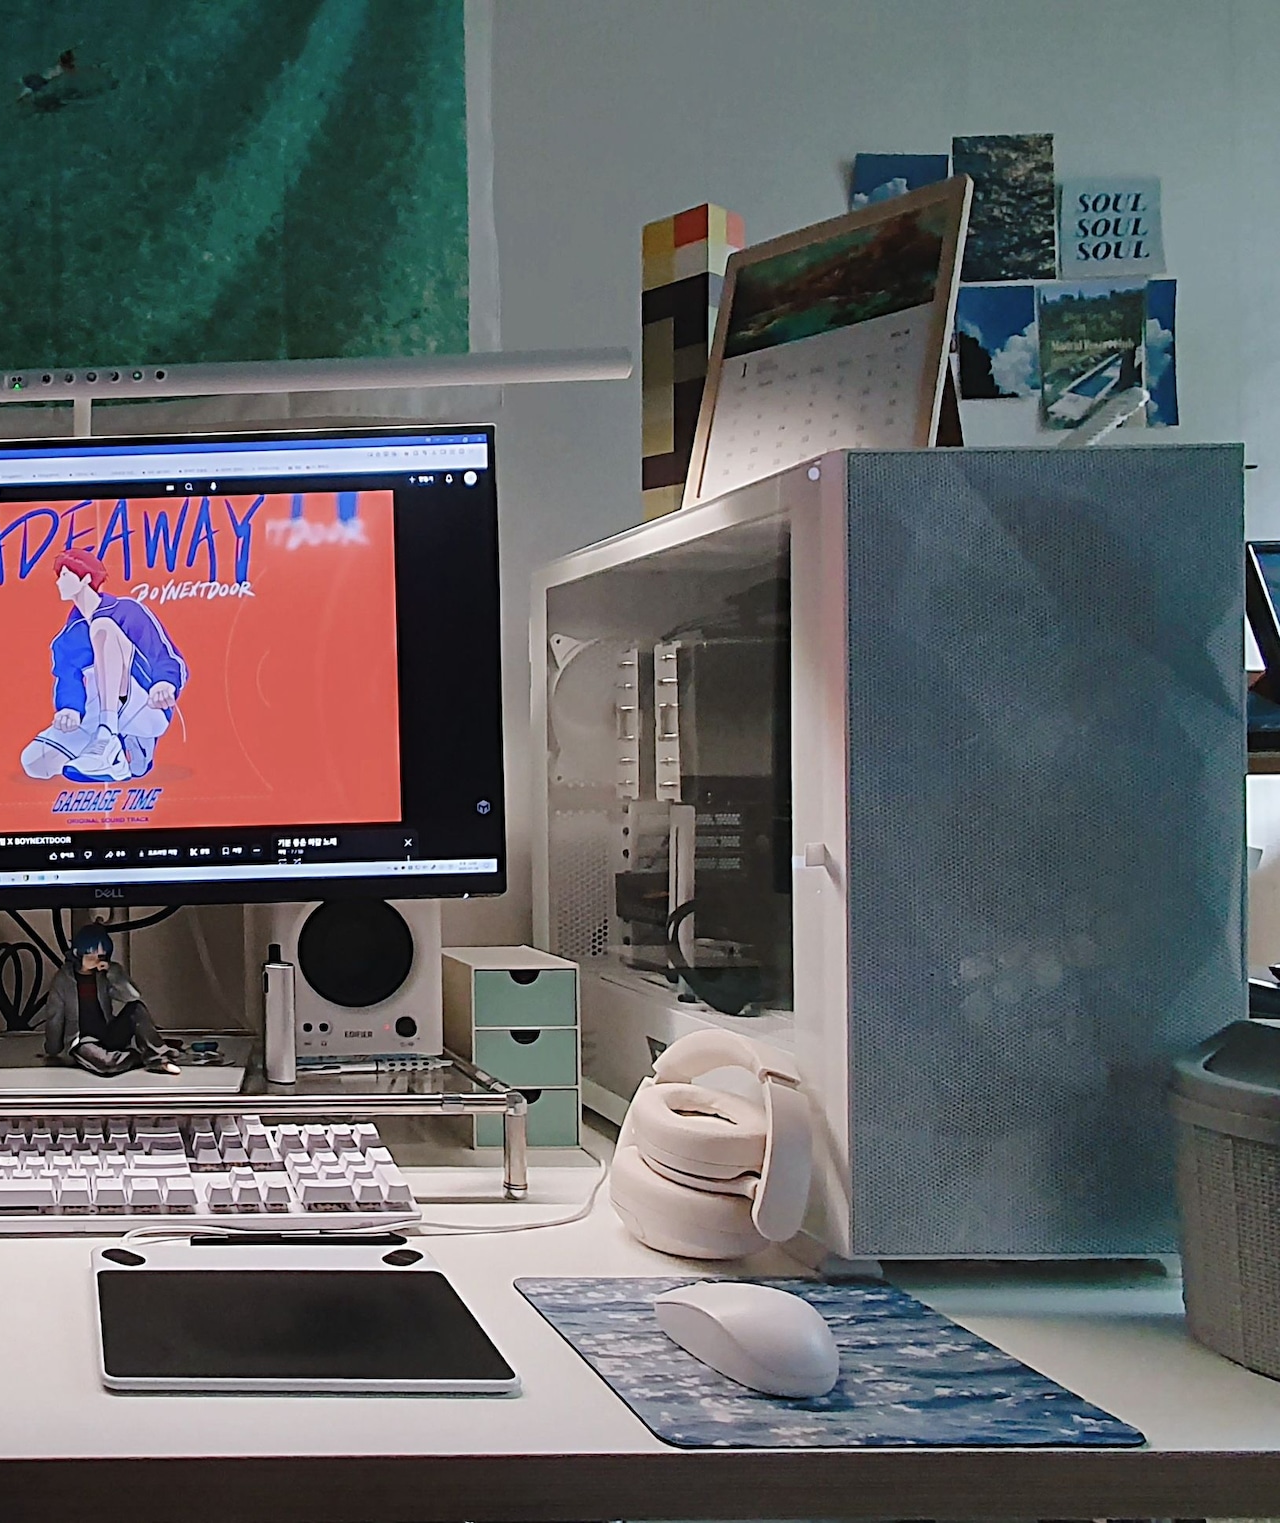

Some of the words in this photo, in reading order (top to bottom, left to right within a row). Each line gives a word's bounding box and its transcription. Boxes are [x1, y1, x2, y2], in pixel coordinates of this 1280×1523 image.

[1077, 192, 1147, 213] SOUL
[1076, 217, 1148, 238] SOUL
[1076, 240, 1150, 262] SOUL
[131, 579, 256, 602] BOYNEXTDOOR
[52, 789, 122, 813] GARBAGE
[121, 787, 163, 811] TIME
[14, 836, 72, 845] BOYNEXTDOOR
[94, 888, 125, 899] DELL
